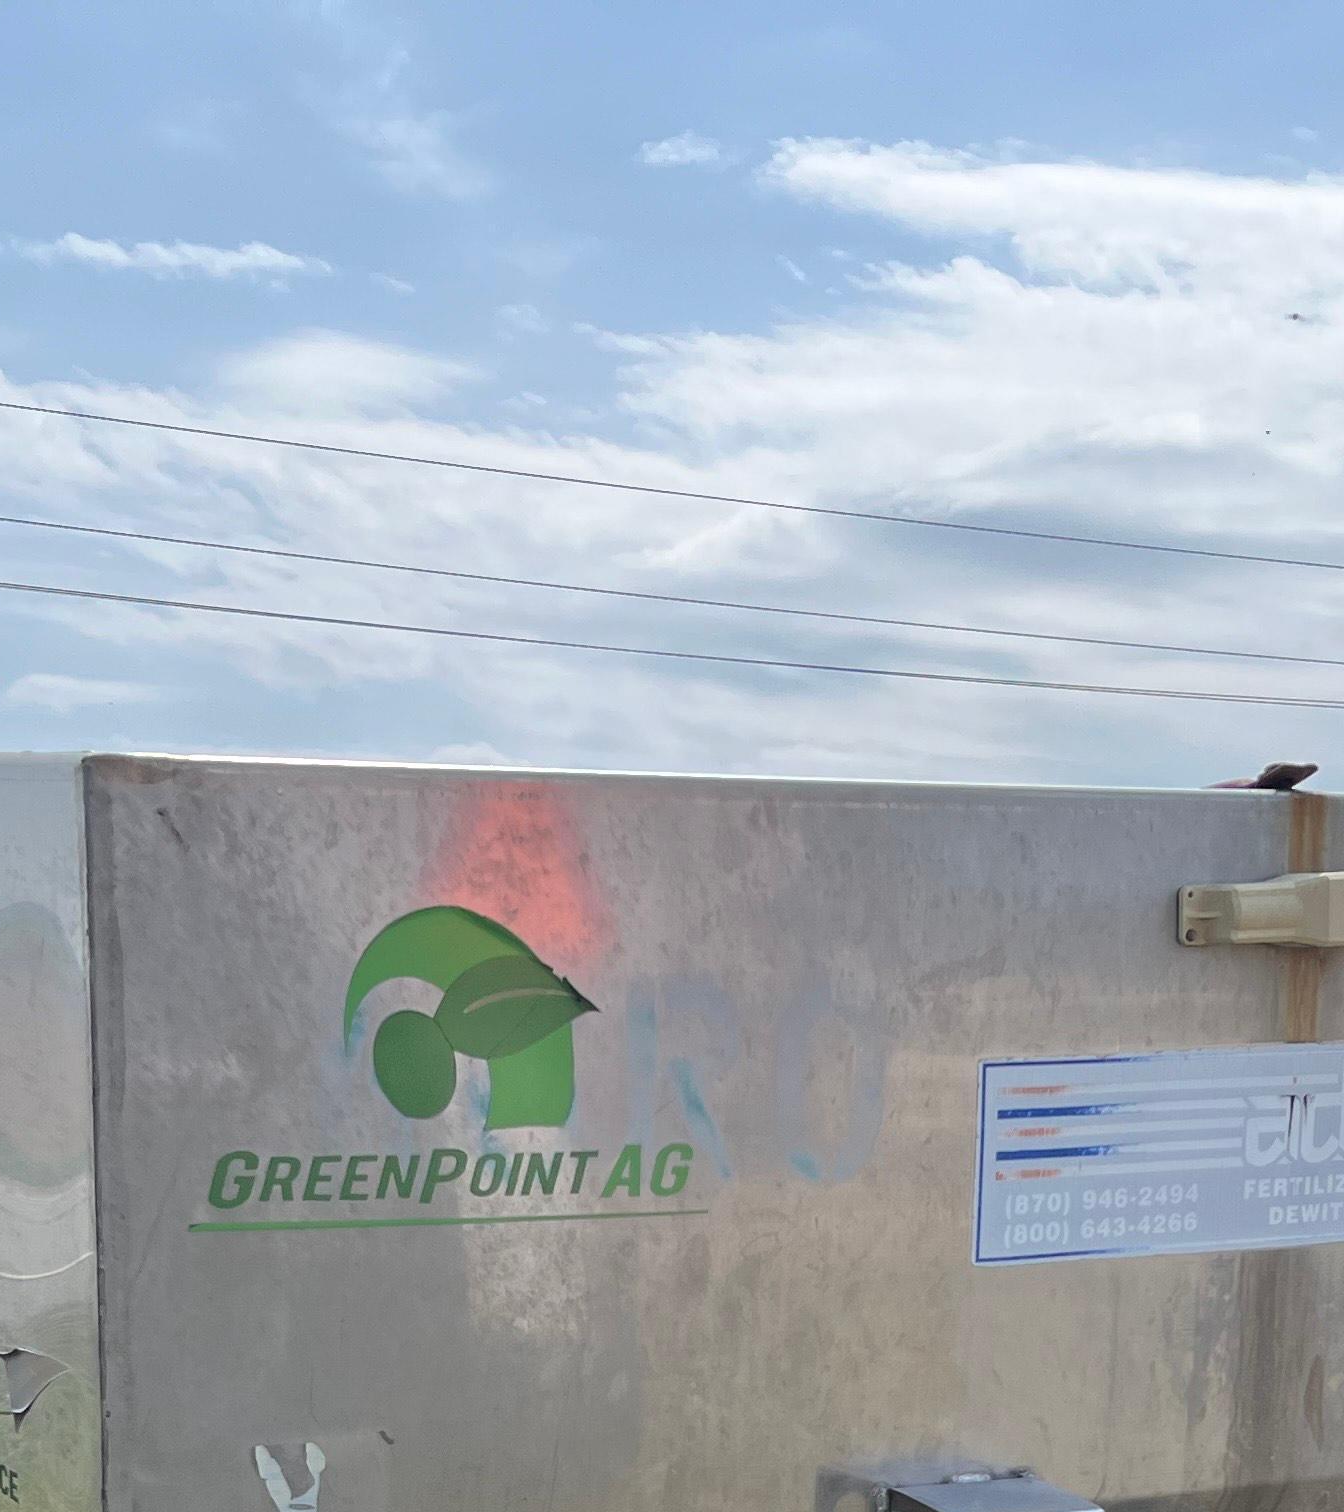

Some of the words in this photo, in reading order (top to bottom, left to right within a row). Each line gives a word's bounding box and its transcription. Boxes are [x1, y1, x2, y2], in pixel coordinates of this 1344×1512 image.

[601, 1142, 695, 1199] AG
[1006, 1191, 1071, 1220] (870)
[1081, 1182, 1199, 1211] 946-2494
[1003, 1220, 1070, 1249] (800)
[1079, 1211, 1198, 1240] 643-4266
